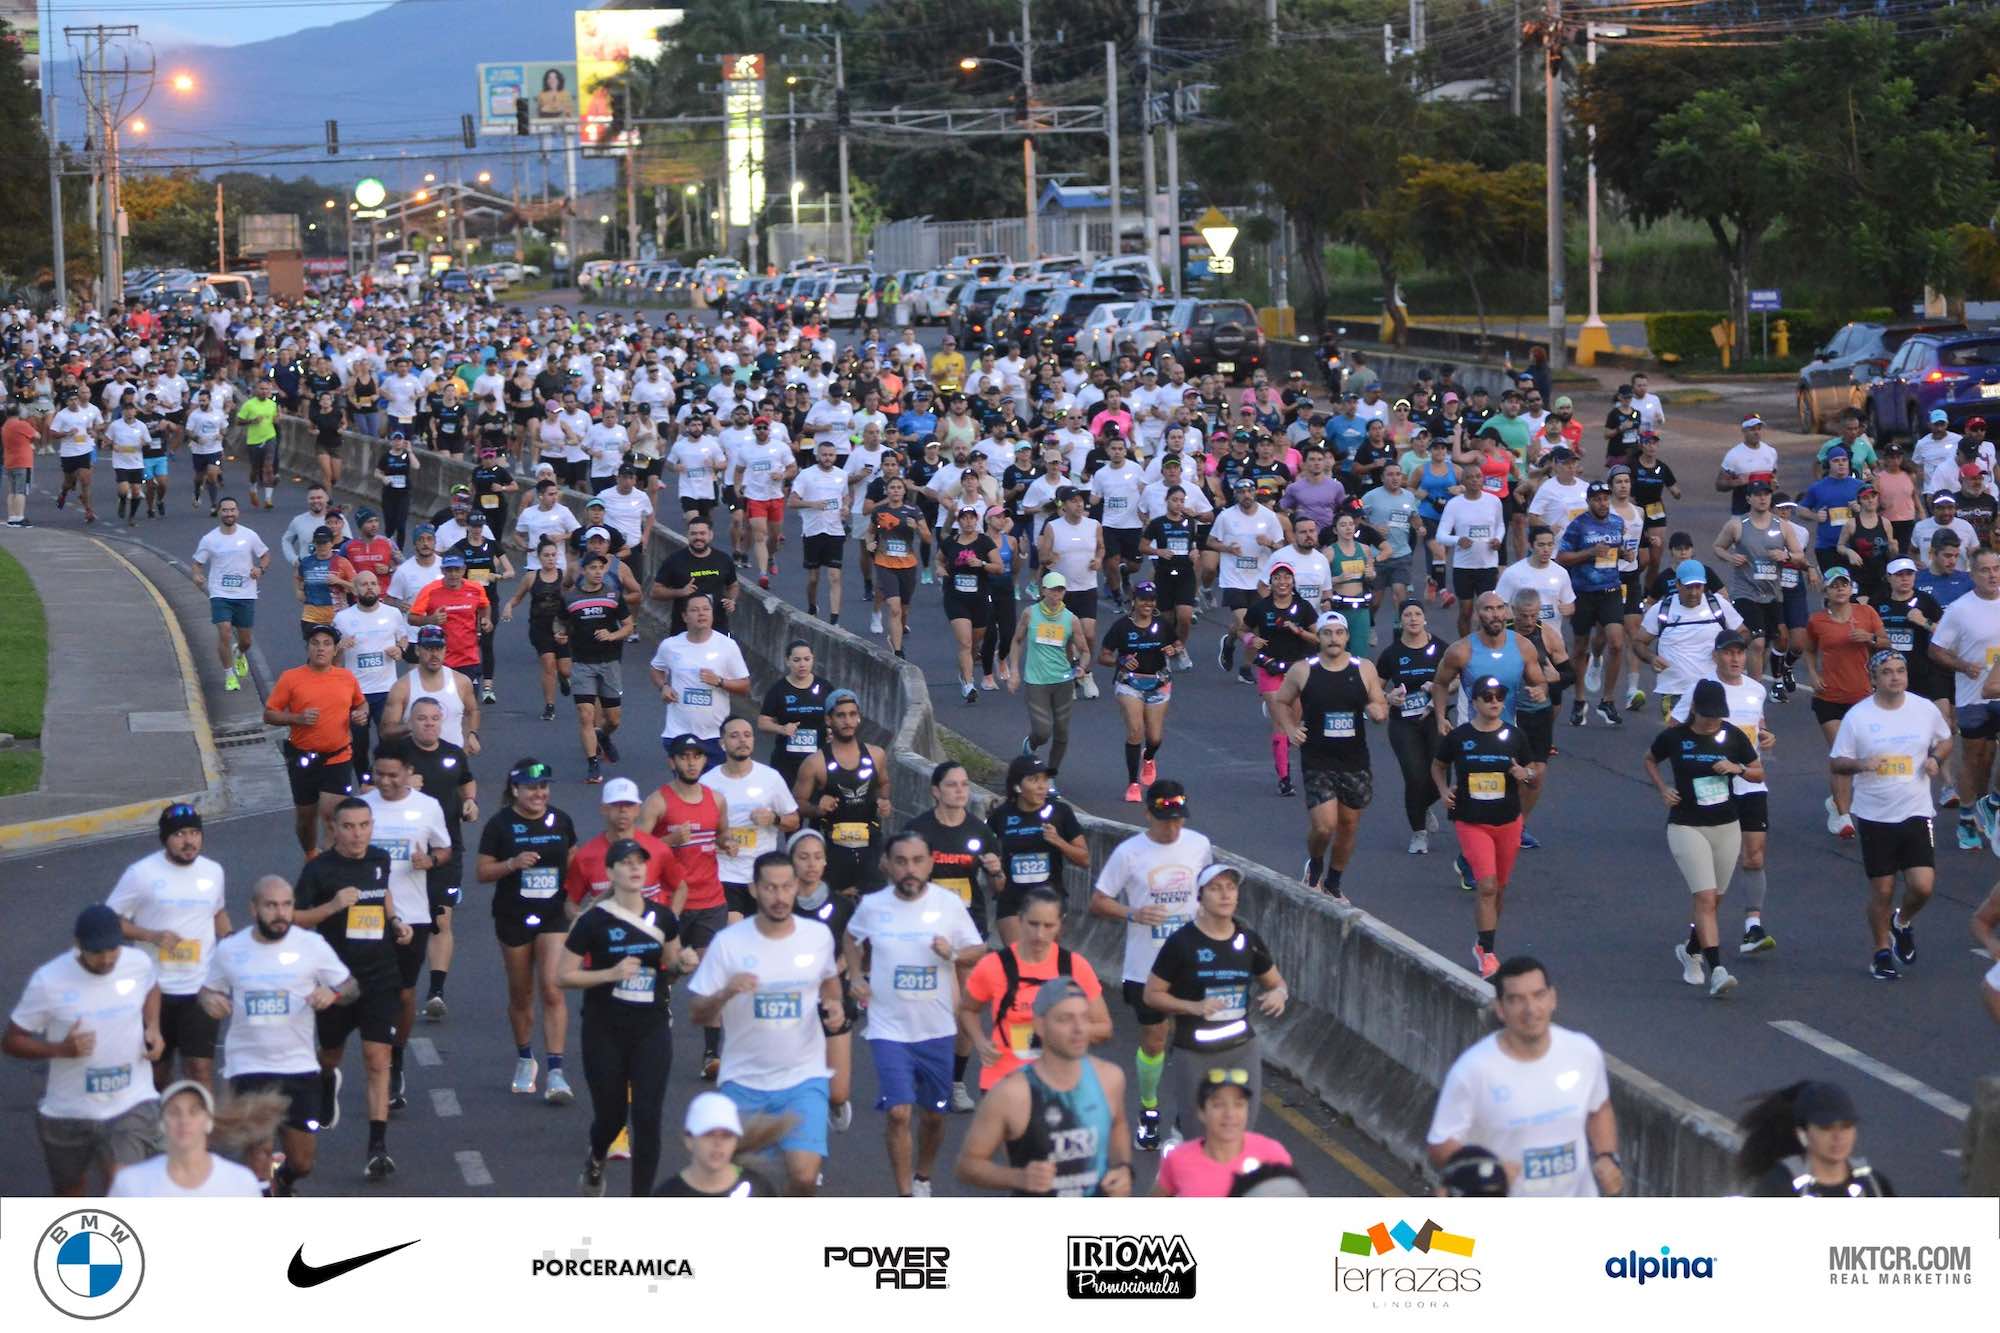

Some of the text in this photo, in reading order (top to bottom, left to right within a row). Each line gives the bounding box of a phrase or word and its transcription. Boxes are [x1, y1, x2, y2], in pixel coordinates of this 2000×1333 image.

[359, 657, 382, 668] 1765
[686, 693, 711, 705] 1659
[1327, 717, 1354, 729] 1800
[1015, 861, 1046, 873] 1322
[527, 876, 556, 888] 1209
[897, 974, 934, 988] 2012
[249, 999, 286, 1013] 1965
[760, 1002, 797, 1017] 1971
[1529, 1155, 1574, 1178] 2165
